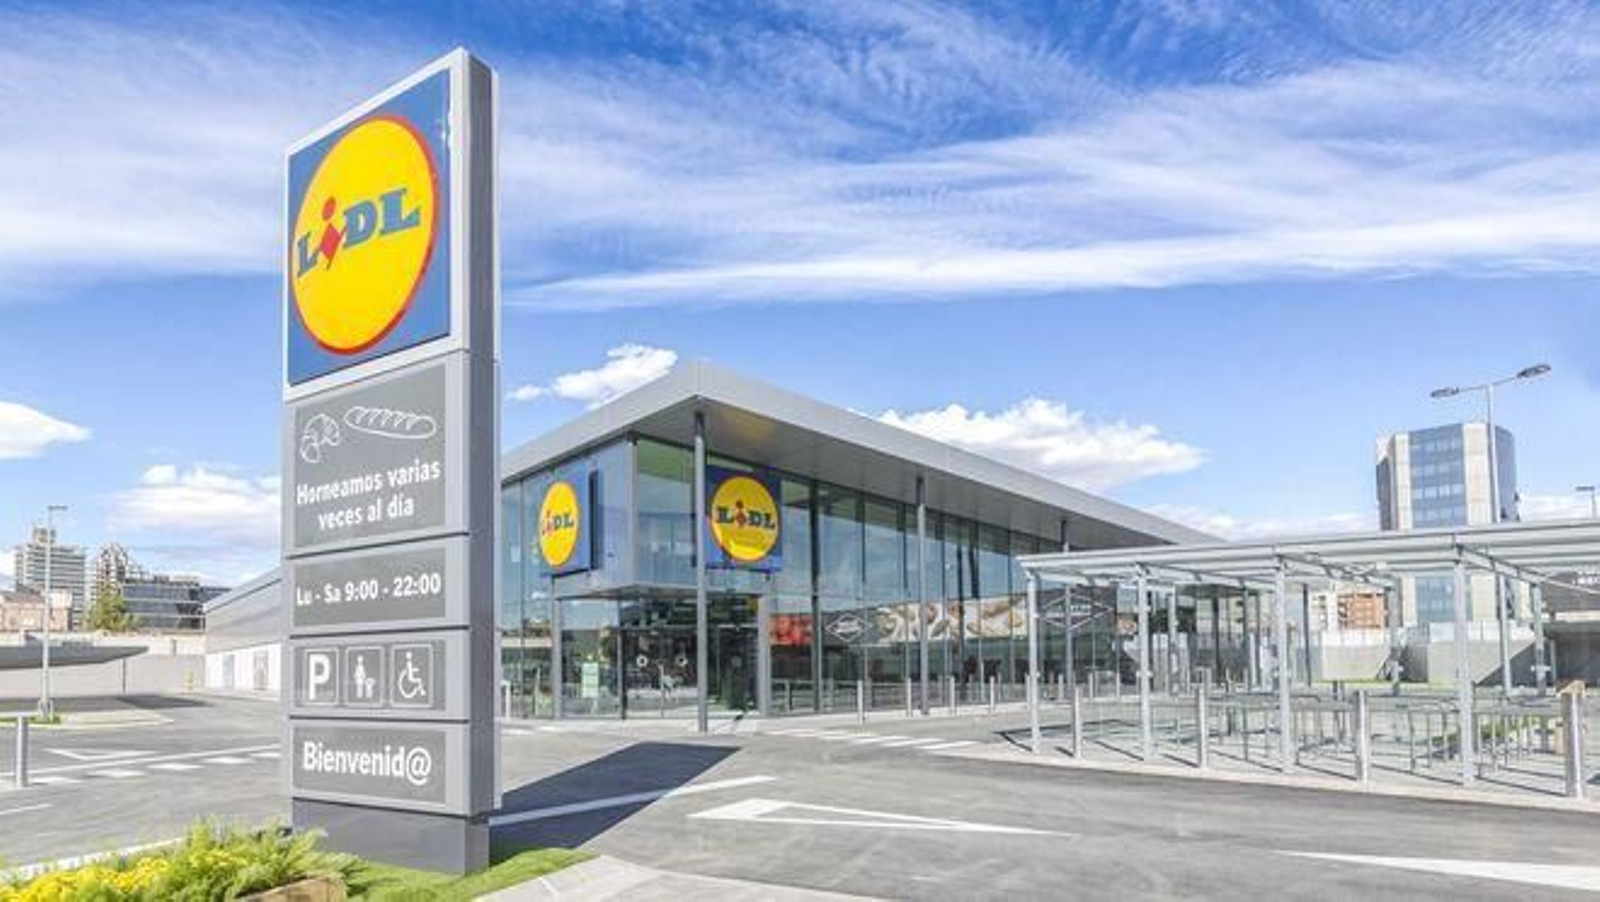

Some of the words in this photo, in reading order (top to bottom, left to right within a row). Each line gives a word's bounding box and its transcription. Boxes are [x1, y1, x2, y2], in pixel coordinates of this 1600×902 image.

[297, 473, 383, 505] Horneamos
[387, 459, 441, 488] varias
[319, 507, 363, 530] veces
[367, 498, 382, 522] al
[387, 493, 415, 518] día
[297, 586, 313, 606] Lu
[324, 583, 341, 603] Sa
[345, 579, 379, 601] 9:00
[393, 573, 441, 597] 22:00
[309, 653, 330, 700] P
[303, 740, 432, 785] Bienvenid@
